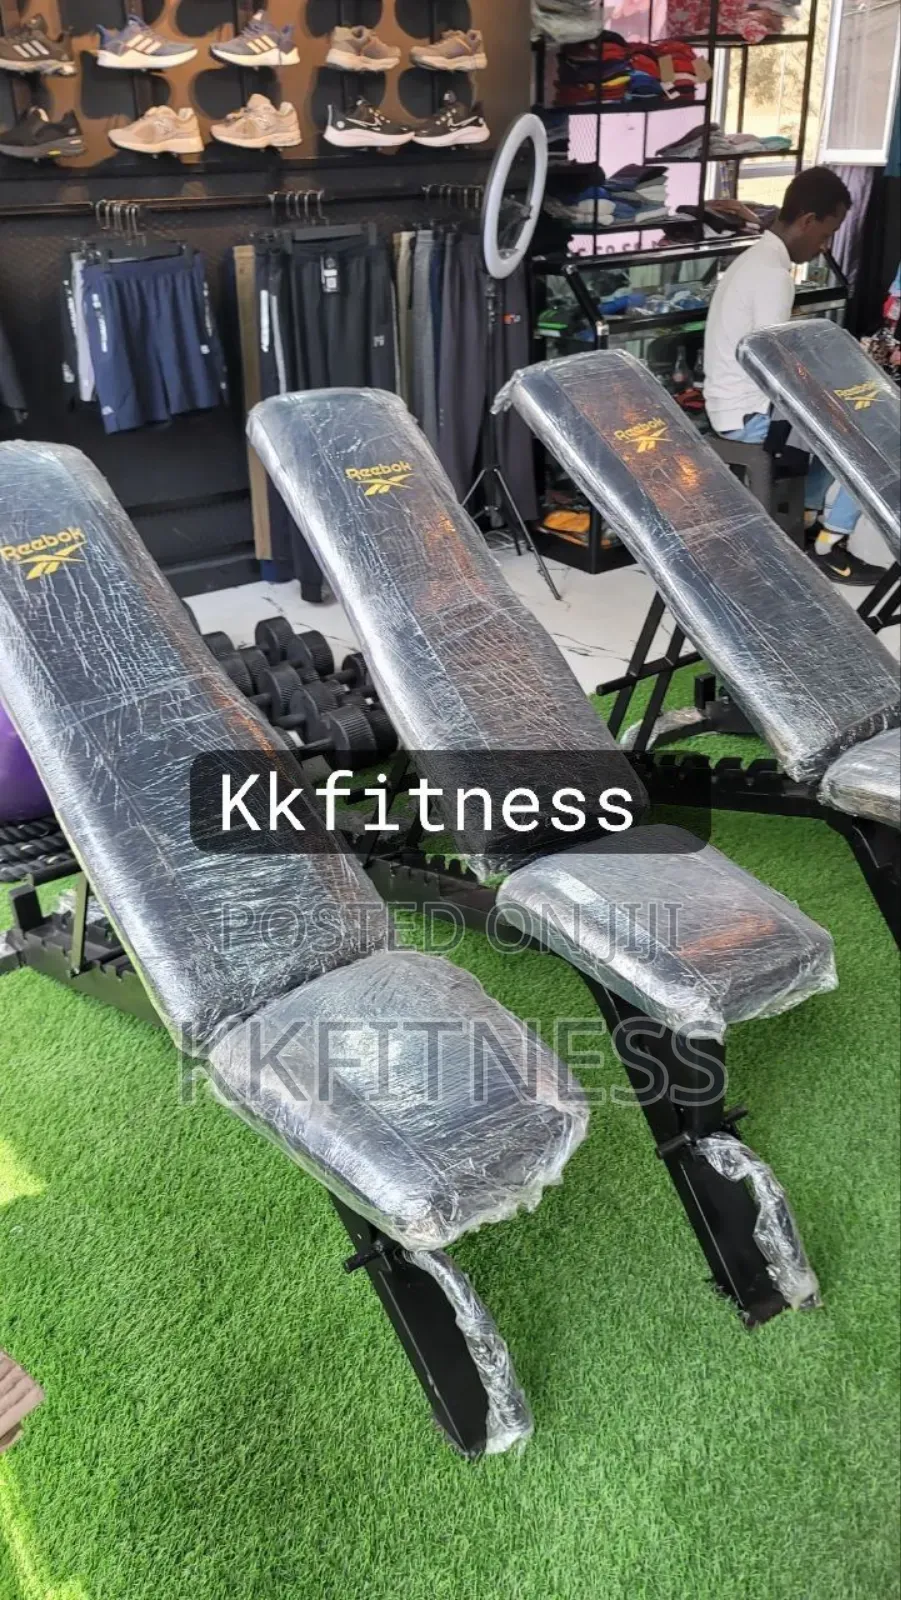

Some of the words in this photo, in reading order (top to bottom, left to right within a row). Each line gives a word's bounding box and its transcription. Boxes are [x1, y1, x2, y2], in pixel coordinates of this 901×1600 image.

[614, 417, 667, 440] Reebok
[345, 460, 412, 480] Reebok
[0, 527, 86, 561] Reebok
